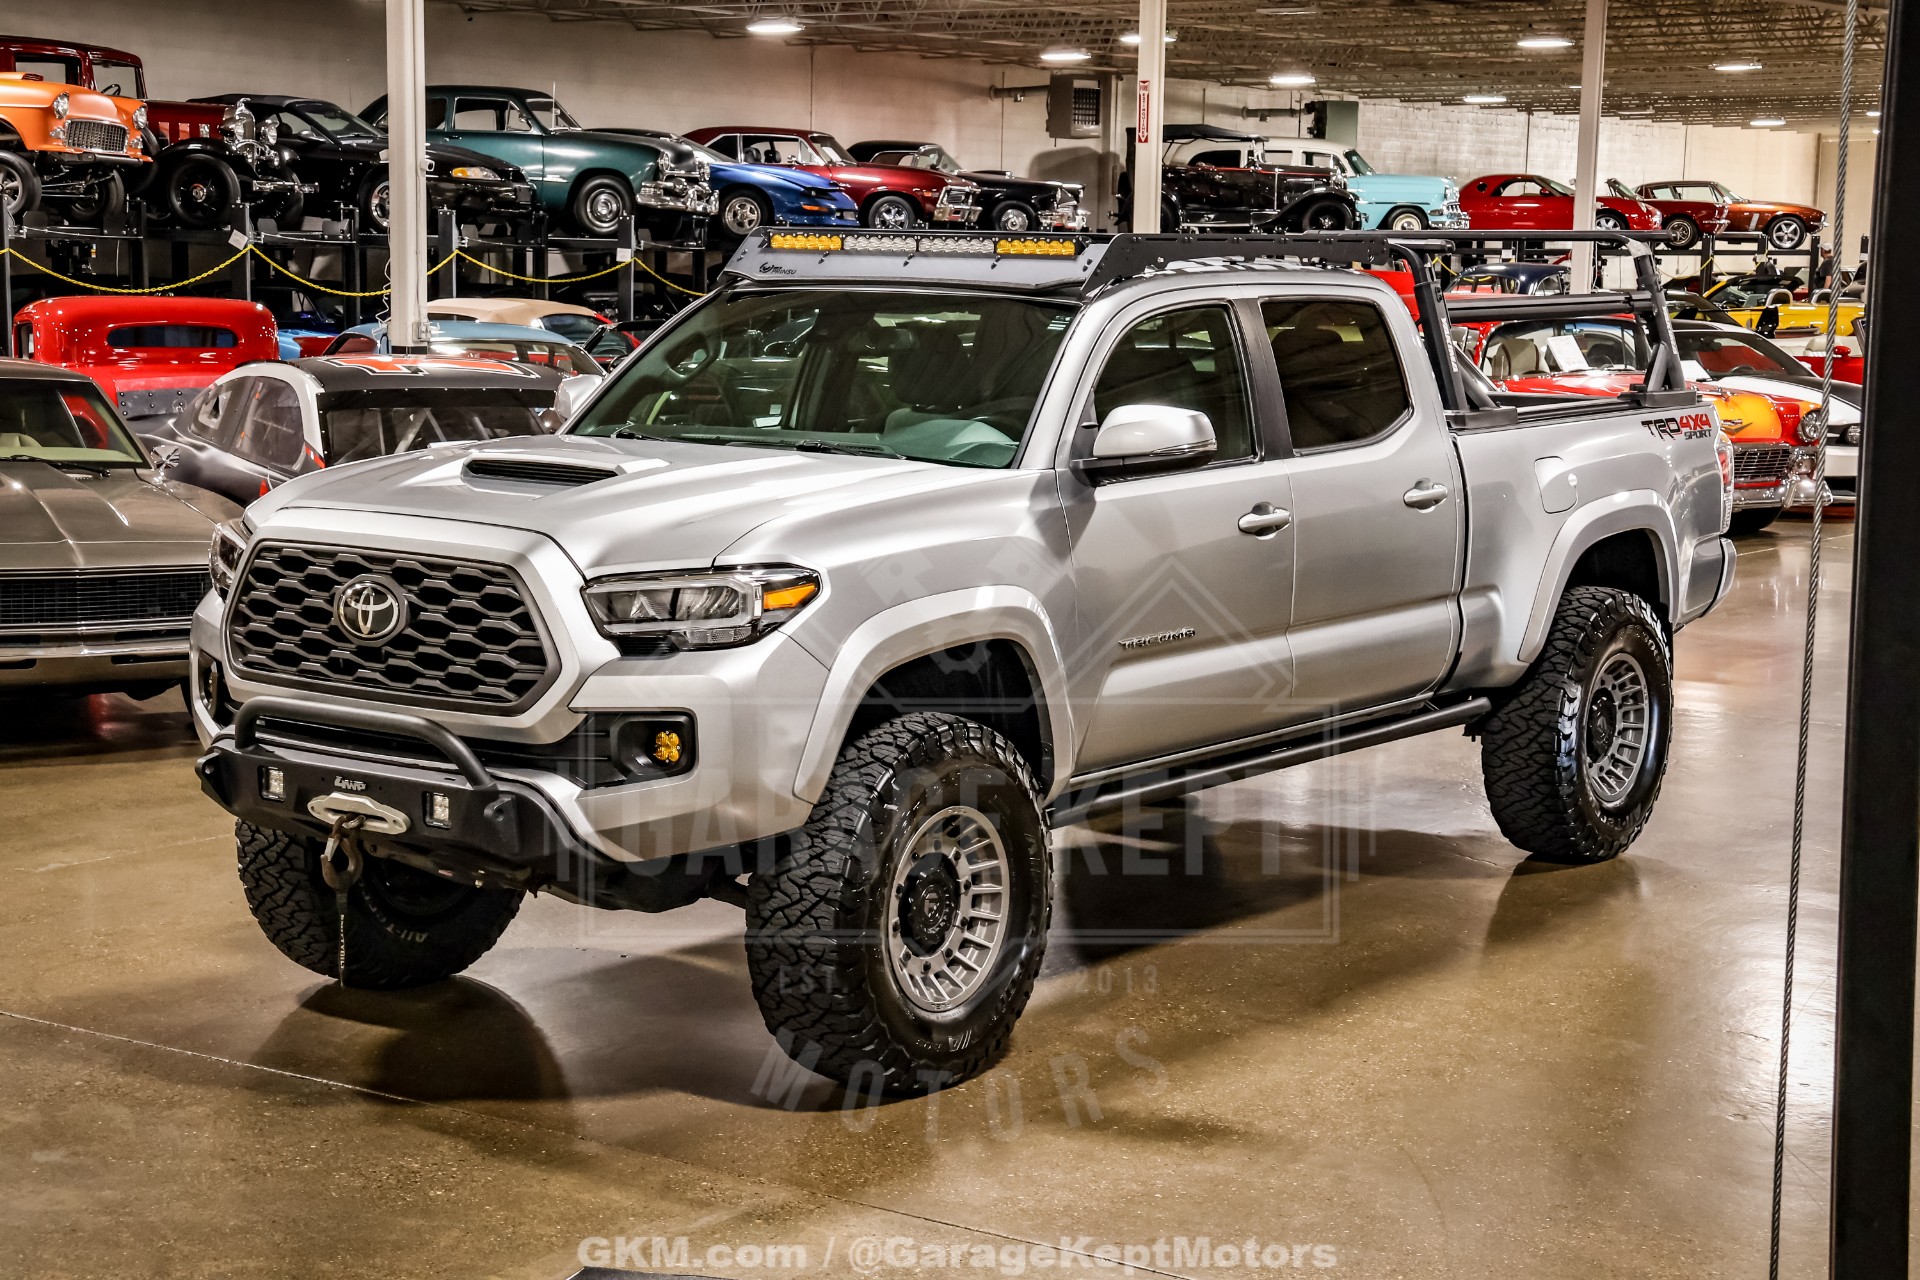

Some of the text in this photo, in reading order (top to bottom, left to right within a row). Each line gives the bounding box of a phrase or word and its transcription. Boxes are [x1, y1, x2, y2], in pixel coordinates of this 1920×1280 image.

[1641, 417, 1682, 441] TRD
[1684, 429, 1712, 440] SPORT
[1118, 626, 1196, 650] TACOMA
